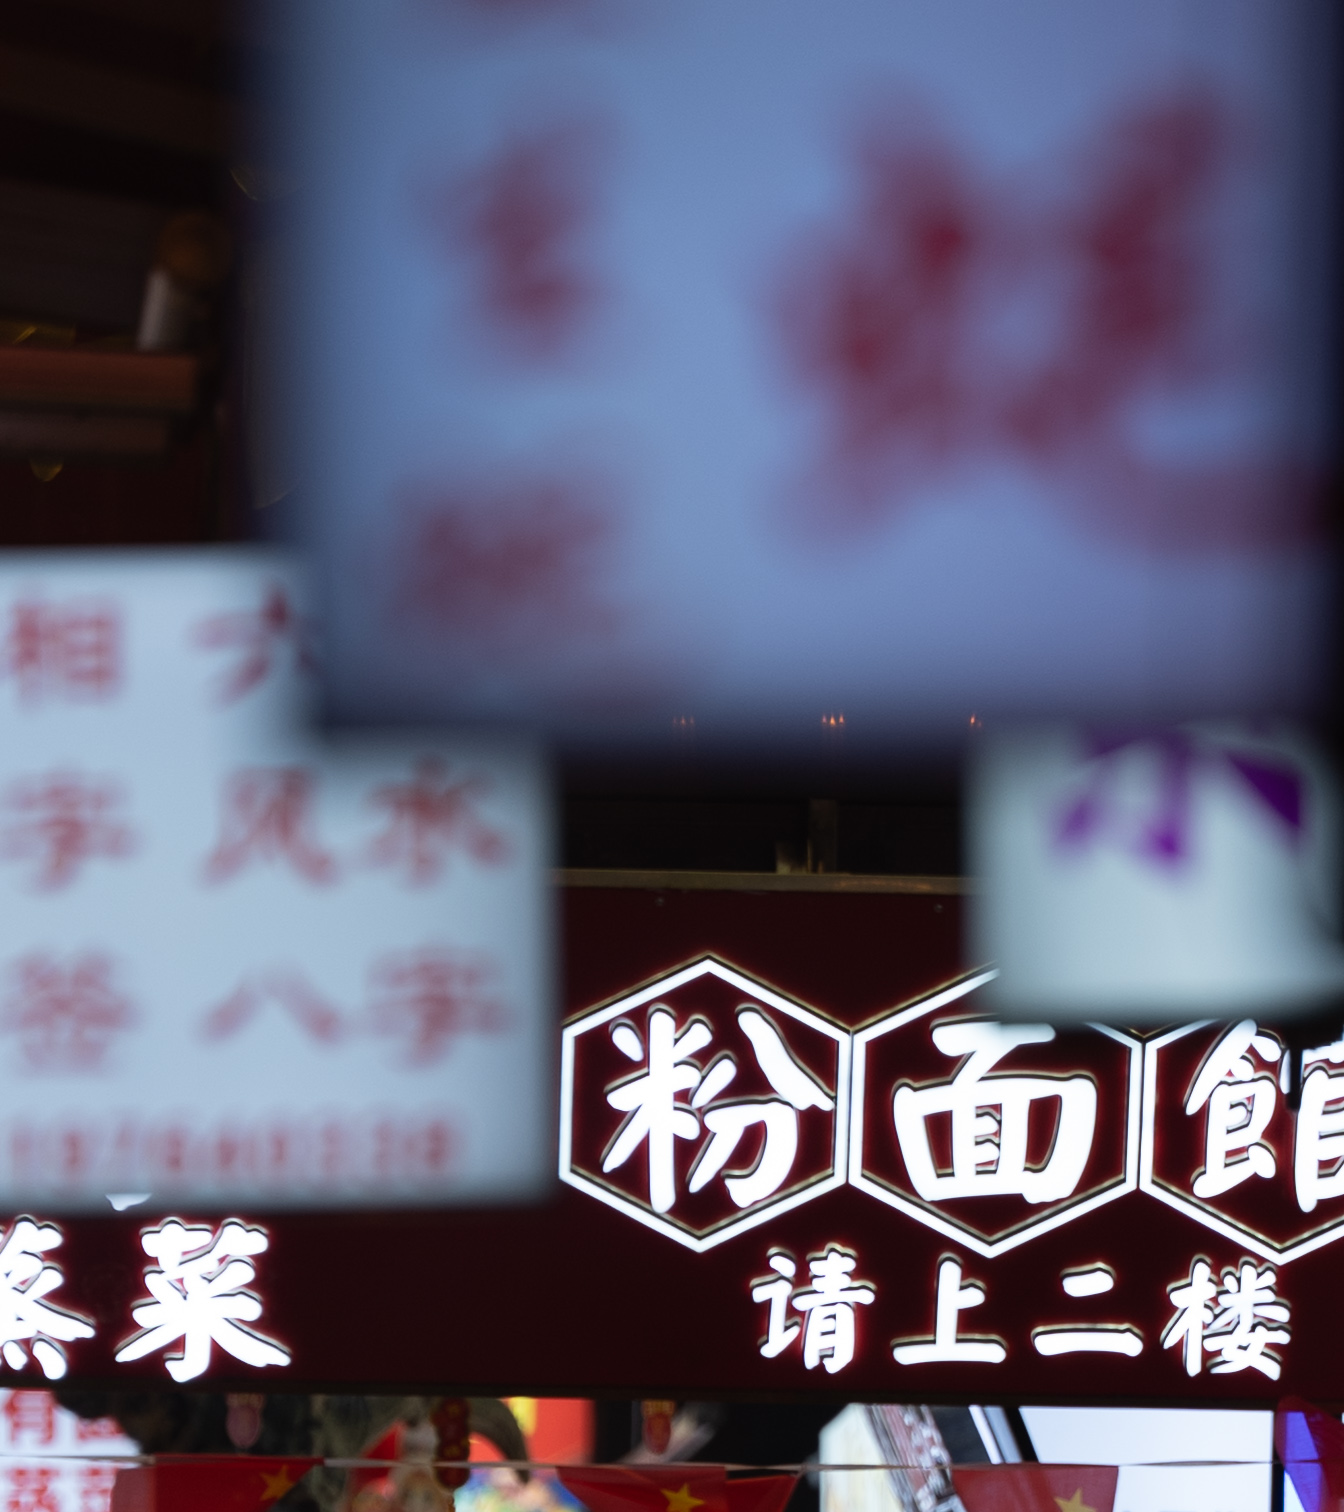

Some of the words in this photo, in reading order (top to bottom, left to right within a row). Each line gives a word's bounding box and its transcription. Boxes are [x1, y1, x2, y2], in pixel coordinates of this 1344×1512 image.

[199, 948, 514, 1068] 八字
[751, 1246, 1294, 1381] 请上二楼
